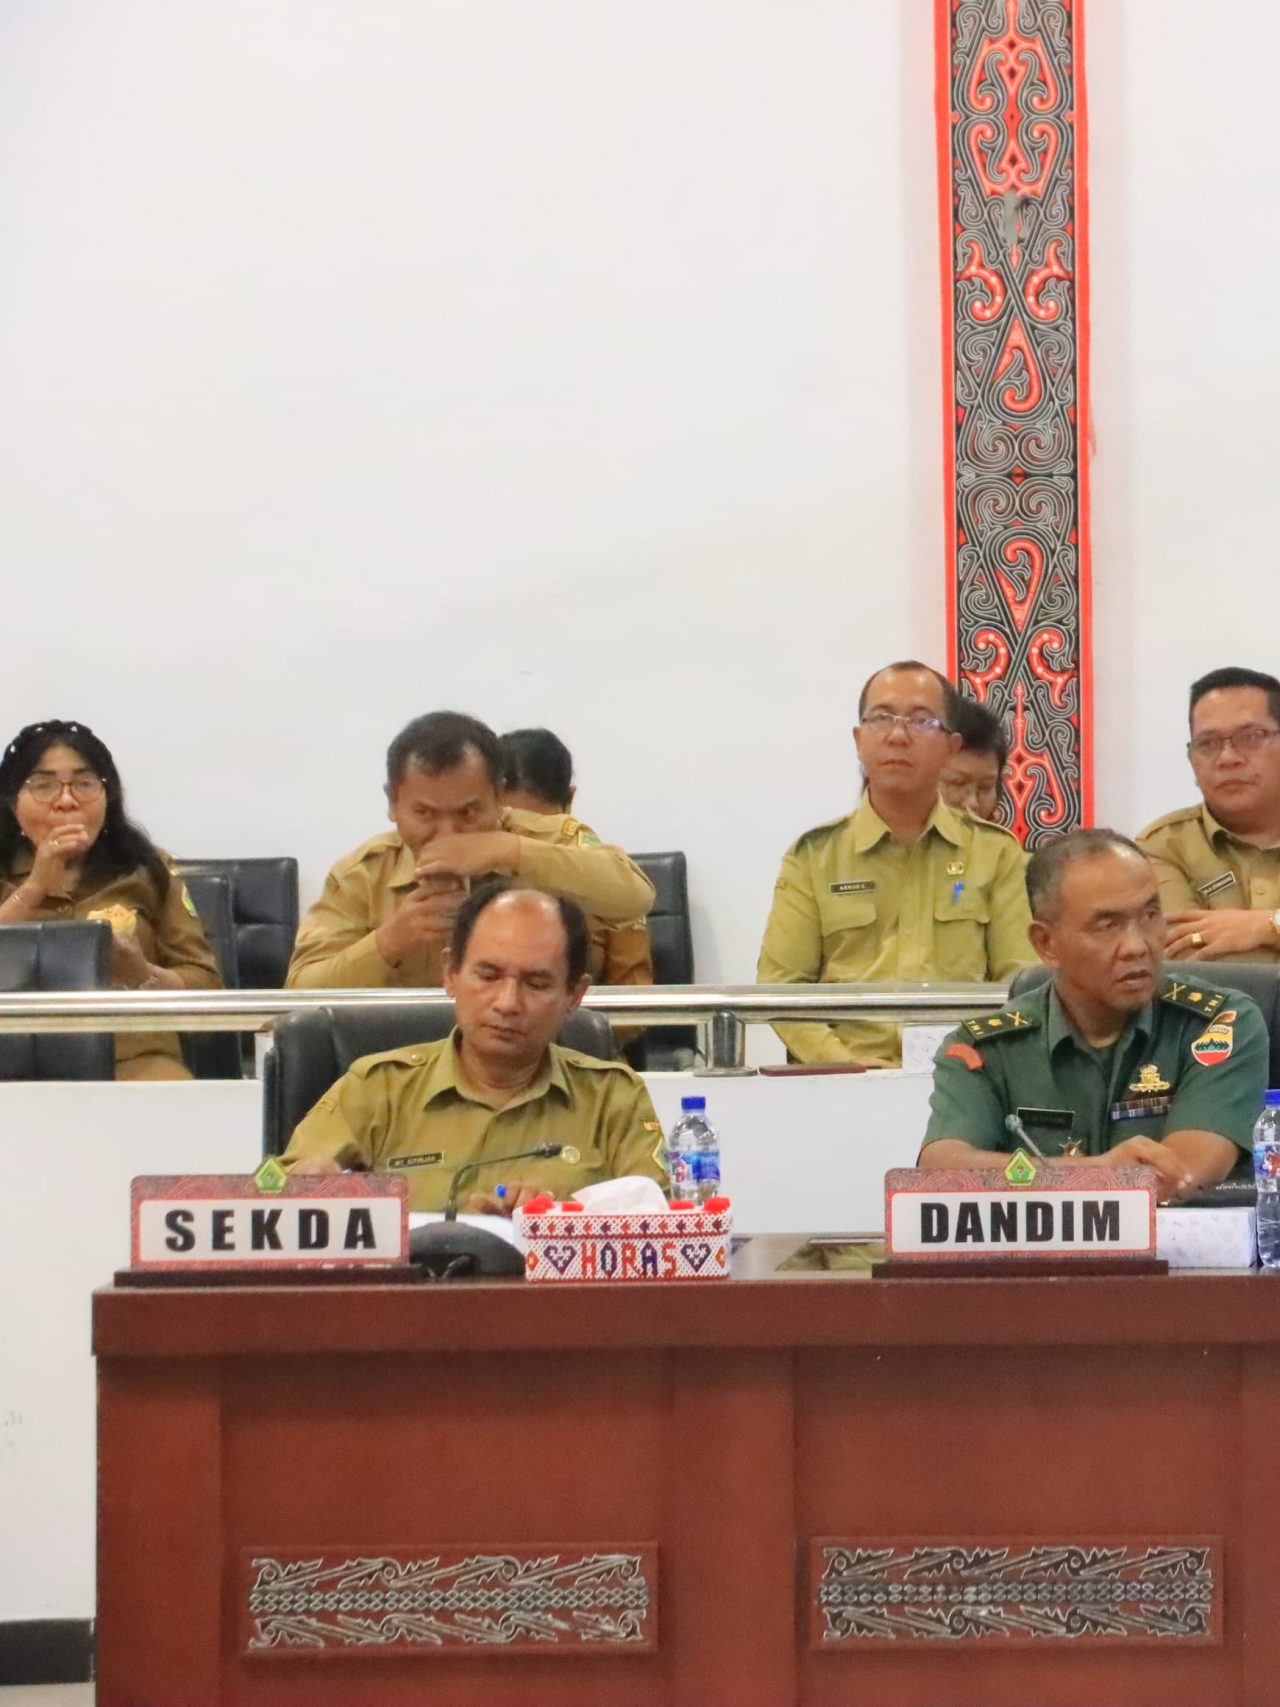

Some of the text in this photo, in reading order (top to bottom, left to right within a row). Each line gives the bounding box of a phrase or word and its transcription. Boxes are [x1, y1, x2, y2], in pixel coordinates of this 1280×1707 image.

[1204, 994, 1223, 1012] TNI
[967, 1020, 985, 1036] TNI
[164, 1209, 377, 1252] SEKDA
[920, 1200, 1120, 1243] DANDIM
[580, 1241, 677, 1279] HORAS
